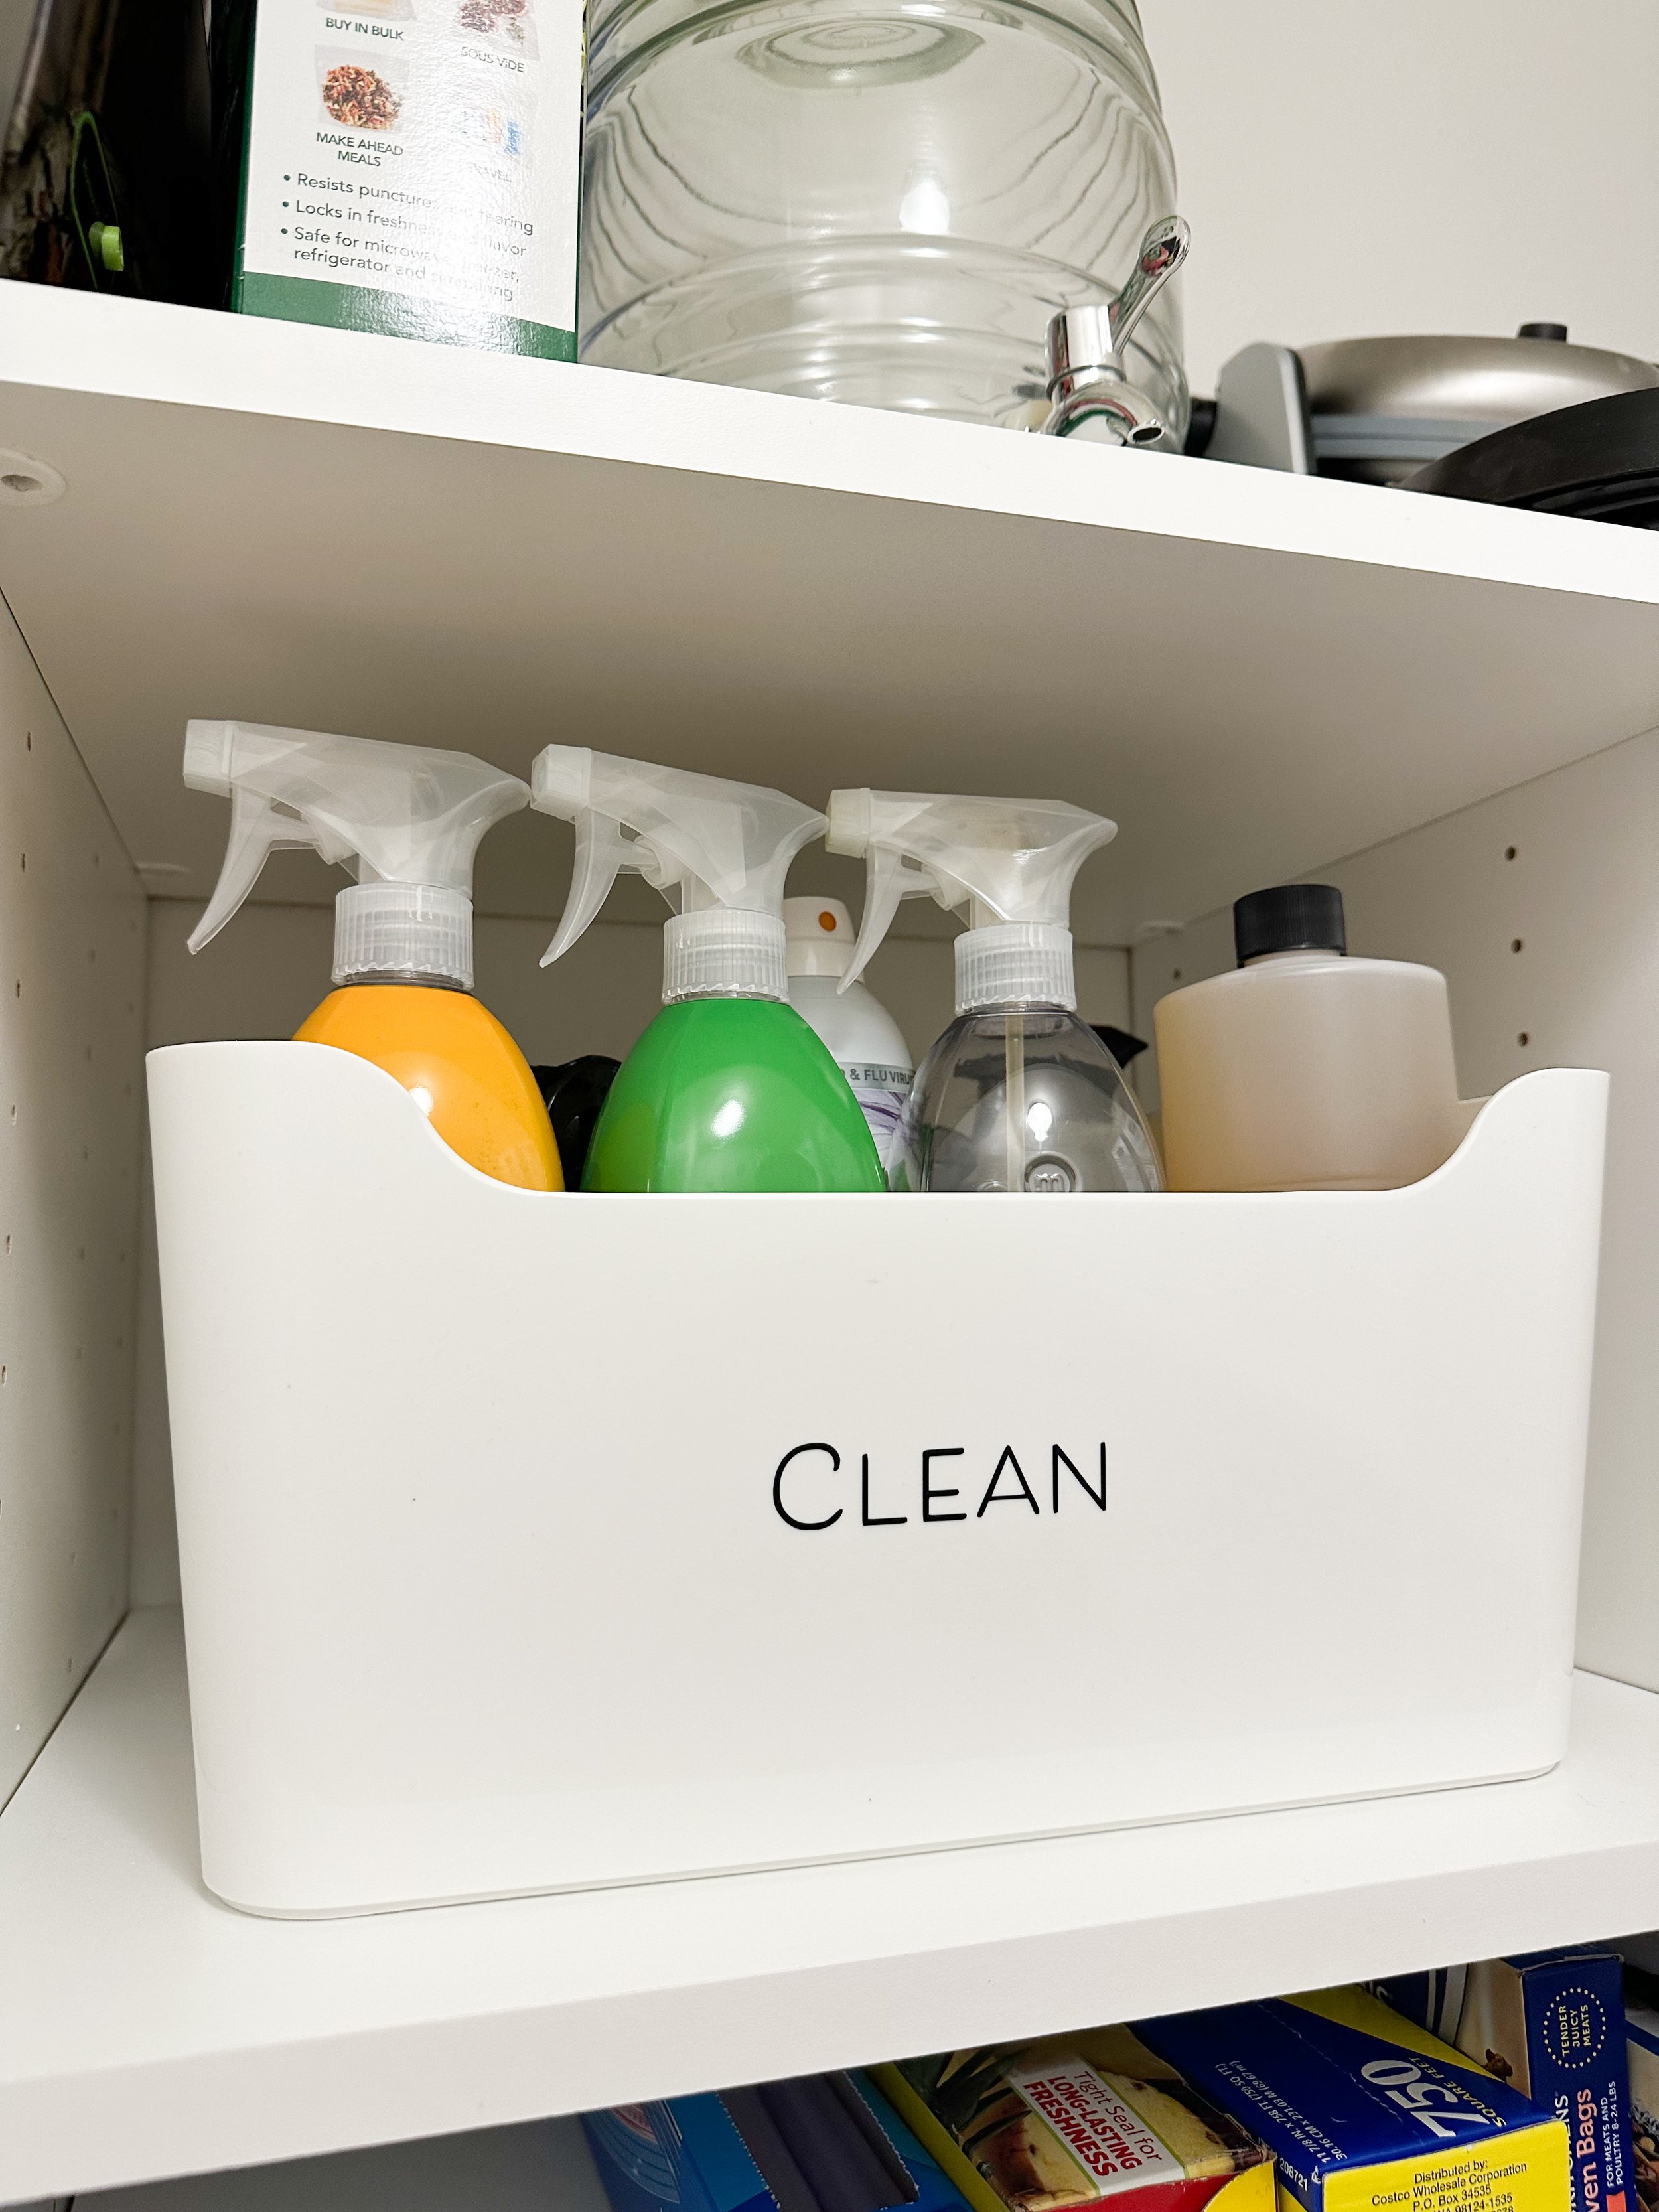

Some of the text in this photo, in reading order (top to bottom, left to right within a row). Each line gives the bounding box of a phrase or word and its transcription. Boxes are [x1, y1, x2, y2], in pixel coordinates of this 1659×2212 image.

[326, 18, 404, 41] BUY IN BULK
[461, 46, 525, 73] SOUS VIDE
[316, 132, 404, 156] MAKE AHEAD
[338, 151, 382, 167] MEALS
[297, 173, 354, 193] Resists
[296, 199, 342, 218] Locks
[347, 207, 362, 222] in
[294, 226, 330, 244] Safe
[335, 232, 359, 248] for
[294, 248, 426, 280] refrigerator and
[849, 1069, 861, 1080] &
[863, 1069, 887, 1082] FLU
[772, 1441, 1107, 1531] CLEAN
[1559, 2005, 1570, 2057] TENDER
[1570, 2010, 1581, 2047] JUICY
[1581, 2004, 1591, 2047] MEATS
[1240, 2086, 1263, 2101] (750
[1263, 2090, 1278, 2099] M
[1360, 2059, 1490, 2138] 750
[1409, 2057, 1508, 2128] SQUARE FEET
[1074, 2070, 1163, 2161] Tight Seal for
[1258, 2100, 1273, 2110] FT.
[1268, 2109, 1287, 2124] 758
[1273, 2098, 1303, 2120] 231.03
[1023, 2081, 1119, 2176] FRESHNESS
[1047, 2075, 1143, 2170] LONG-LASTING
[1291, 2128, 1307, 2140] IN.
[1305, 2126, 1323, 2138] CM
[1608, 2081, 1624, 2186] POULTRY 8-24 LBS
[1301, 2138, 1321, 2153] 7/8
[1319, 2138, 1348, 2160] 30.16
[1576, 2088, 1600, 2212] ven Bags
[1601, 2097, 1615, 2188] FOR MEATS AND
[1316, 2152, 1331, 2164] 11
[1279, 2157, 1309, 2192] 208721
[1413, 2159, 1488, 2184] Distributed by:
[1372, 2162, 1528, 2206] Costco Wholesale Corporation
[1413, 2183, 1492, 2212] P.O. Box 34535
[1455, 2192, 1513, 2212] 98124-1535
